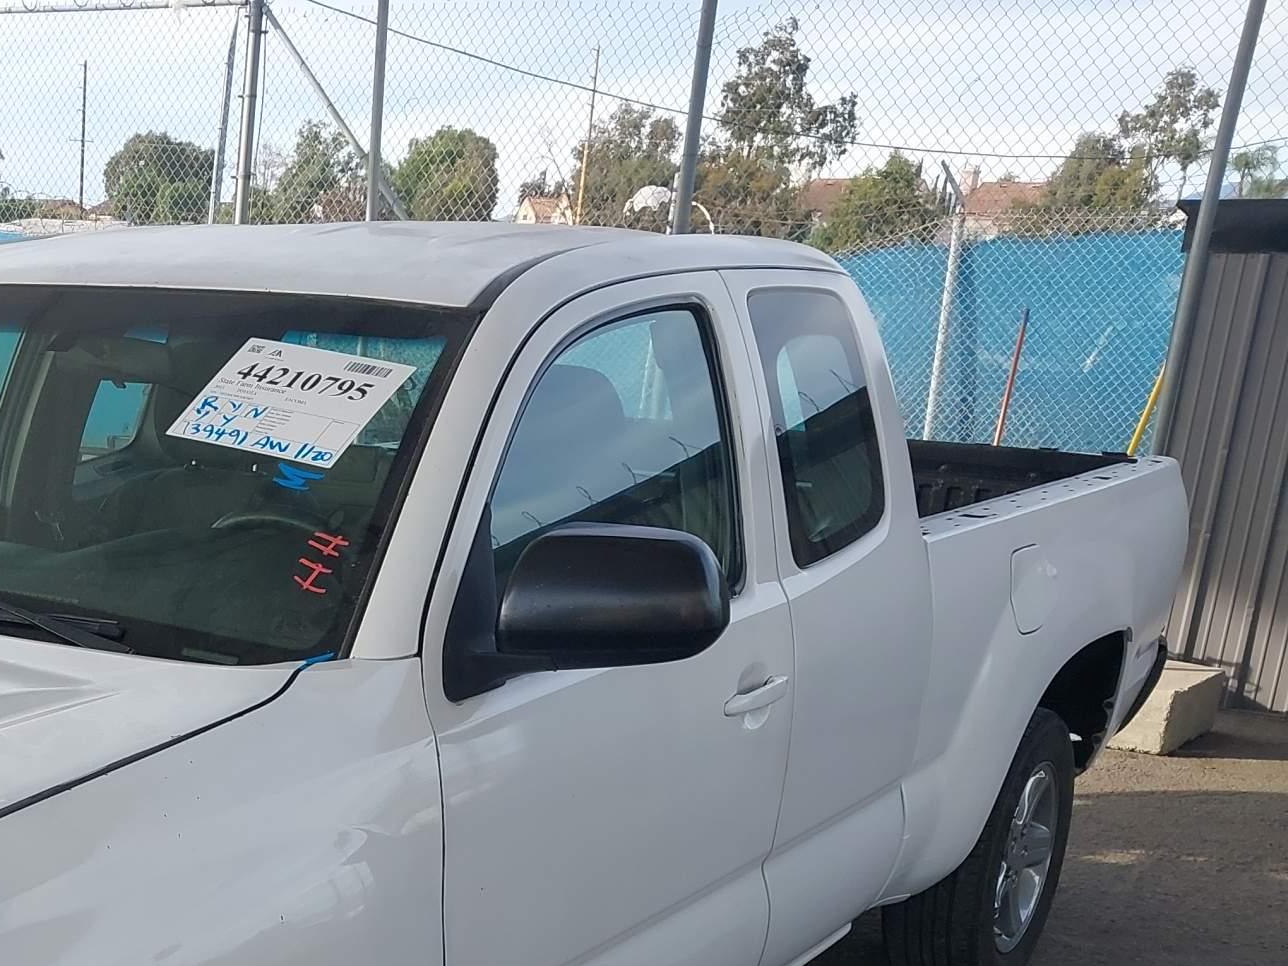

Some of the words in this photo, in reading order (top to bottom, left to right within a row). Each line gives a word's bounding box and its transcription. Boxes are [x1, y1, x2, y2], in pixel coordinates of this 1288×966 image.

[218, 377, 235, 386] State
[235, 380, 255, 389] Farm
[255, 382, 287, 395] Insurance
[237, 362, 375, 400] 44210795
[200, 396, 219, 411] R
[294, 443, 334, 463] 1/20
